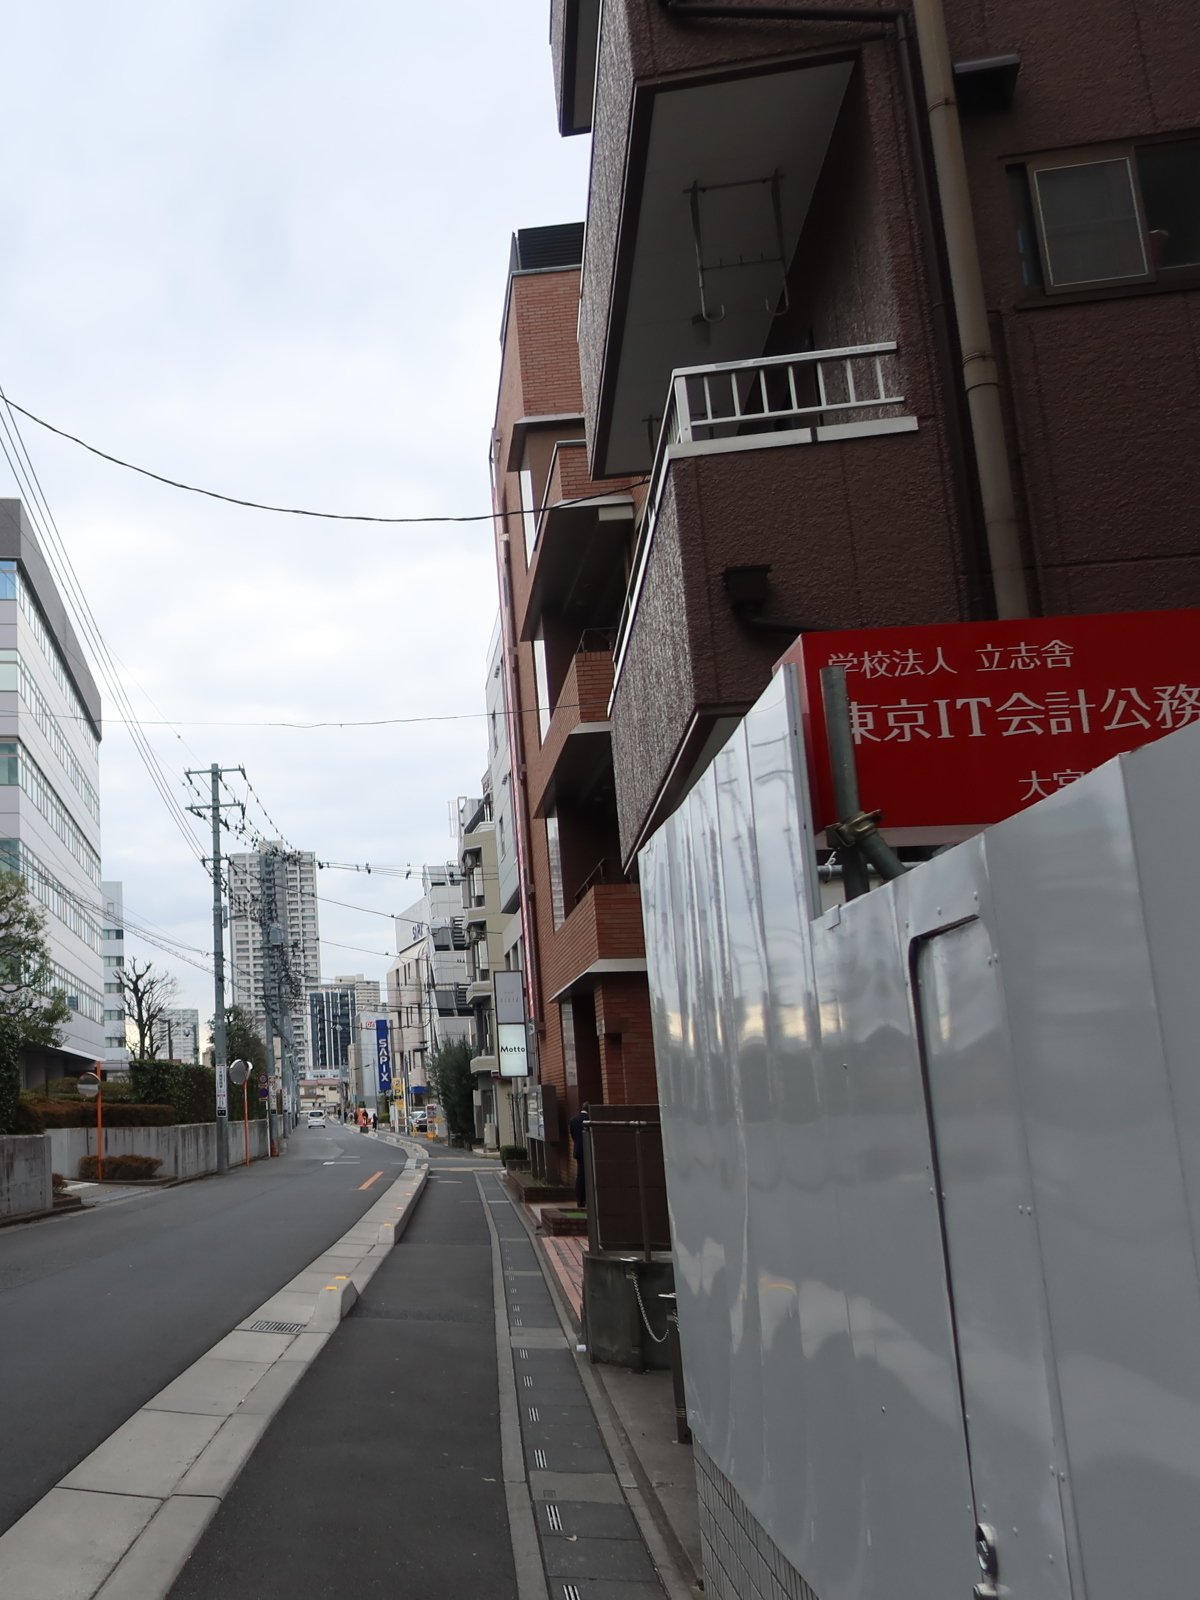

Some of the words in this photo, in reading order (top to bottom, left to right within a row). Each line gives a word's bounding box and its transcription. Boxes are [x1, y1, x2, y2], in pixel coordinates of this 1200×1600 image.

[828, 647, 958, 678] 学校法人
[975, 640, 1074, 671] 立志舎
[1018, 768, 1095, 801] 大宮
[379, 1039, 389, 1082] SAPIX
[500, 1045, 526, 1053] Motto
